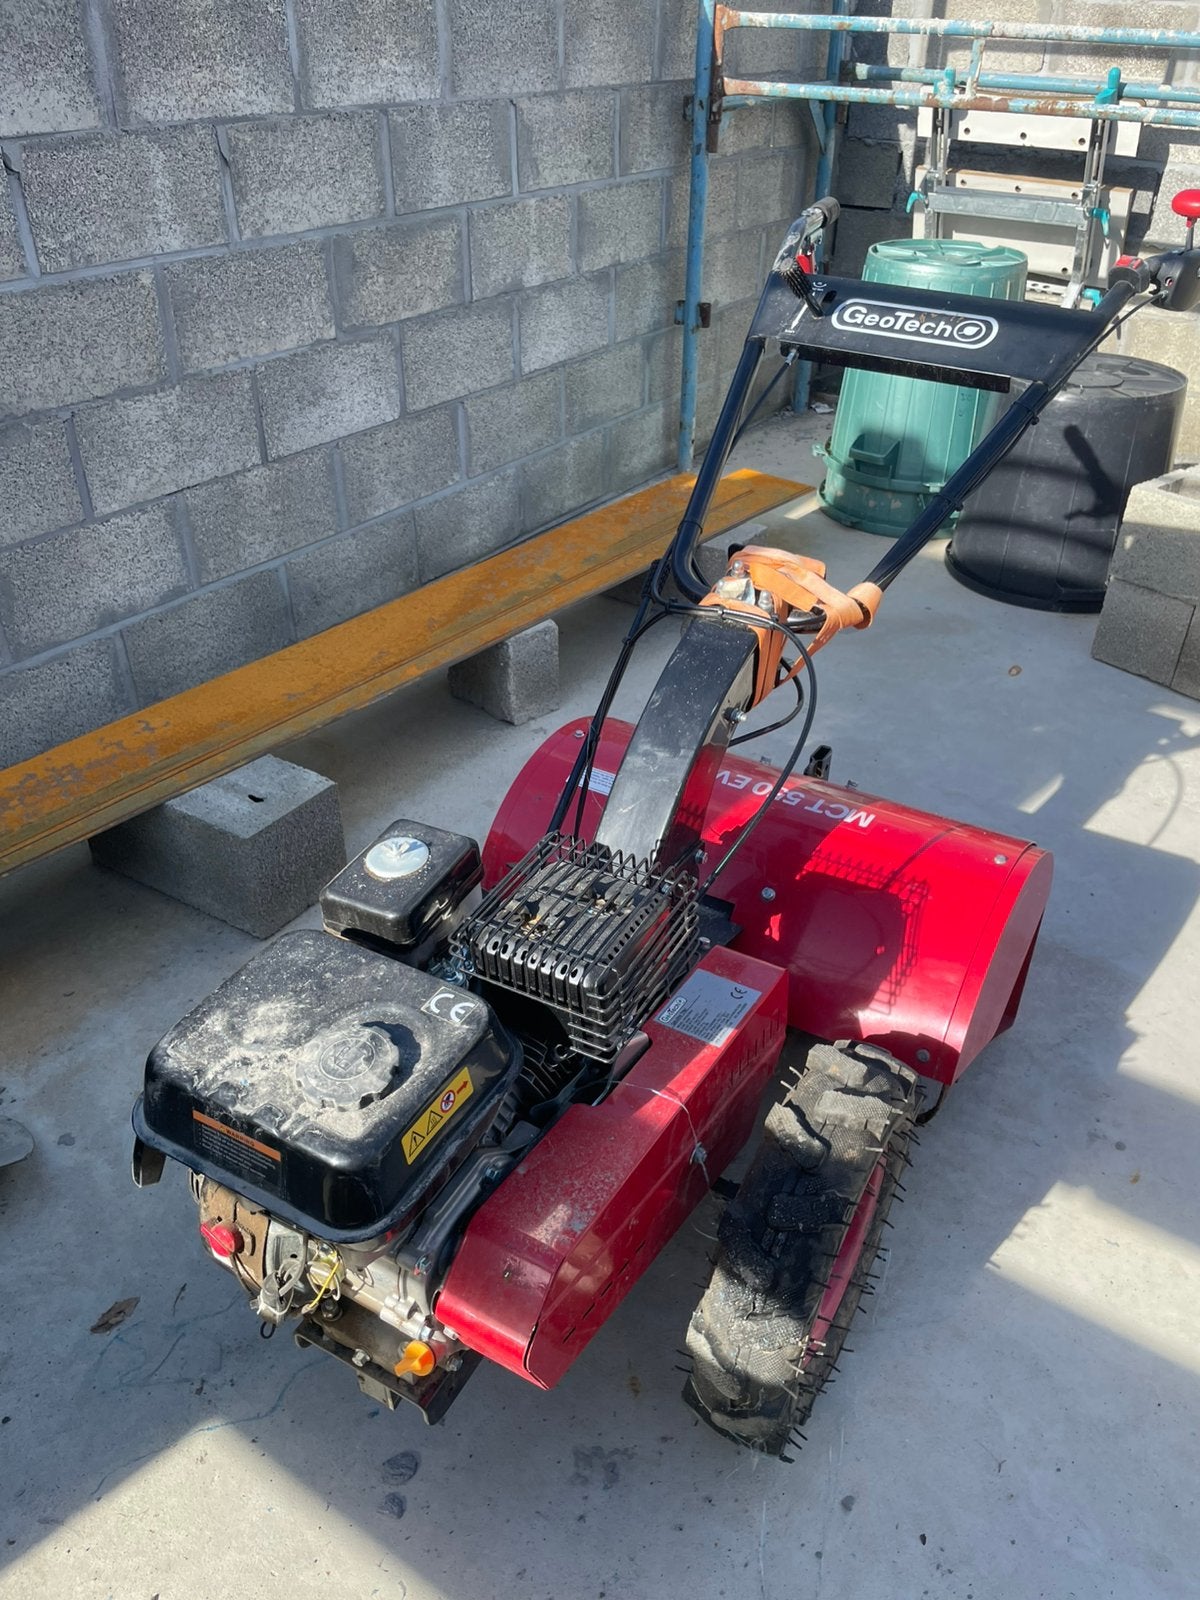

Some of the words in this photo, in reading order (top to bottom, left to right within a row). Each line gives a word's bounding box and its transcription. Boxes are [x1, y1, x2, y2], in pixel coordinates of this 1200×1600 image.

[843, 306, 952, 337] GeoTech
[805, 799, 875, 828] MCT
[430, 992, 475, 1023] CE
[226, 1128, 255, 1147] WARNING
